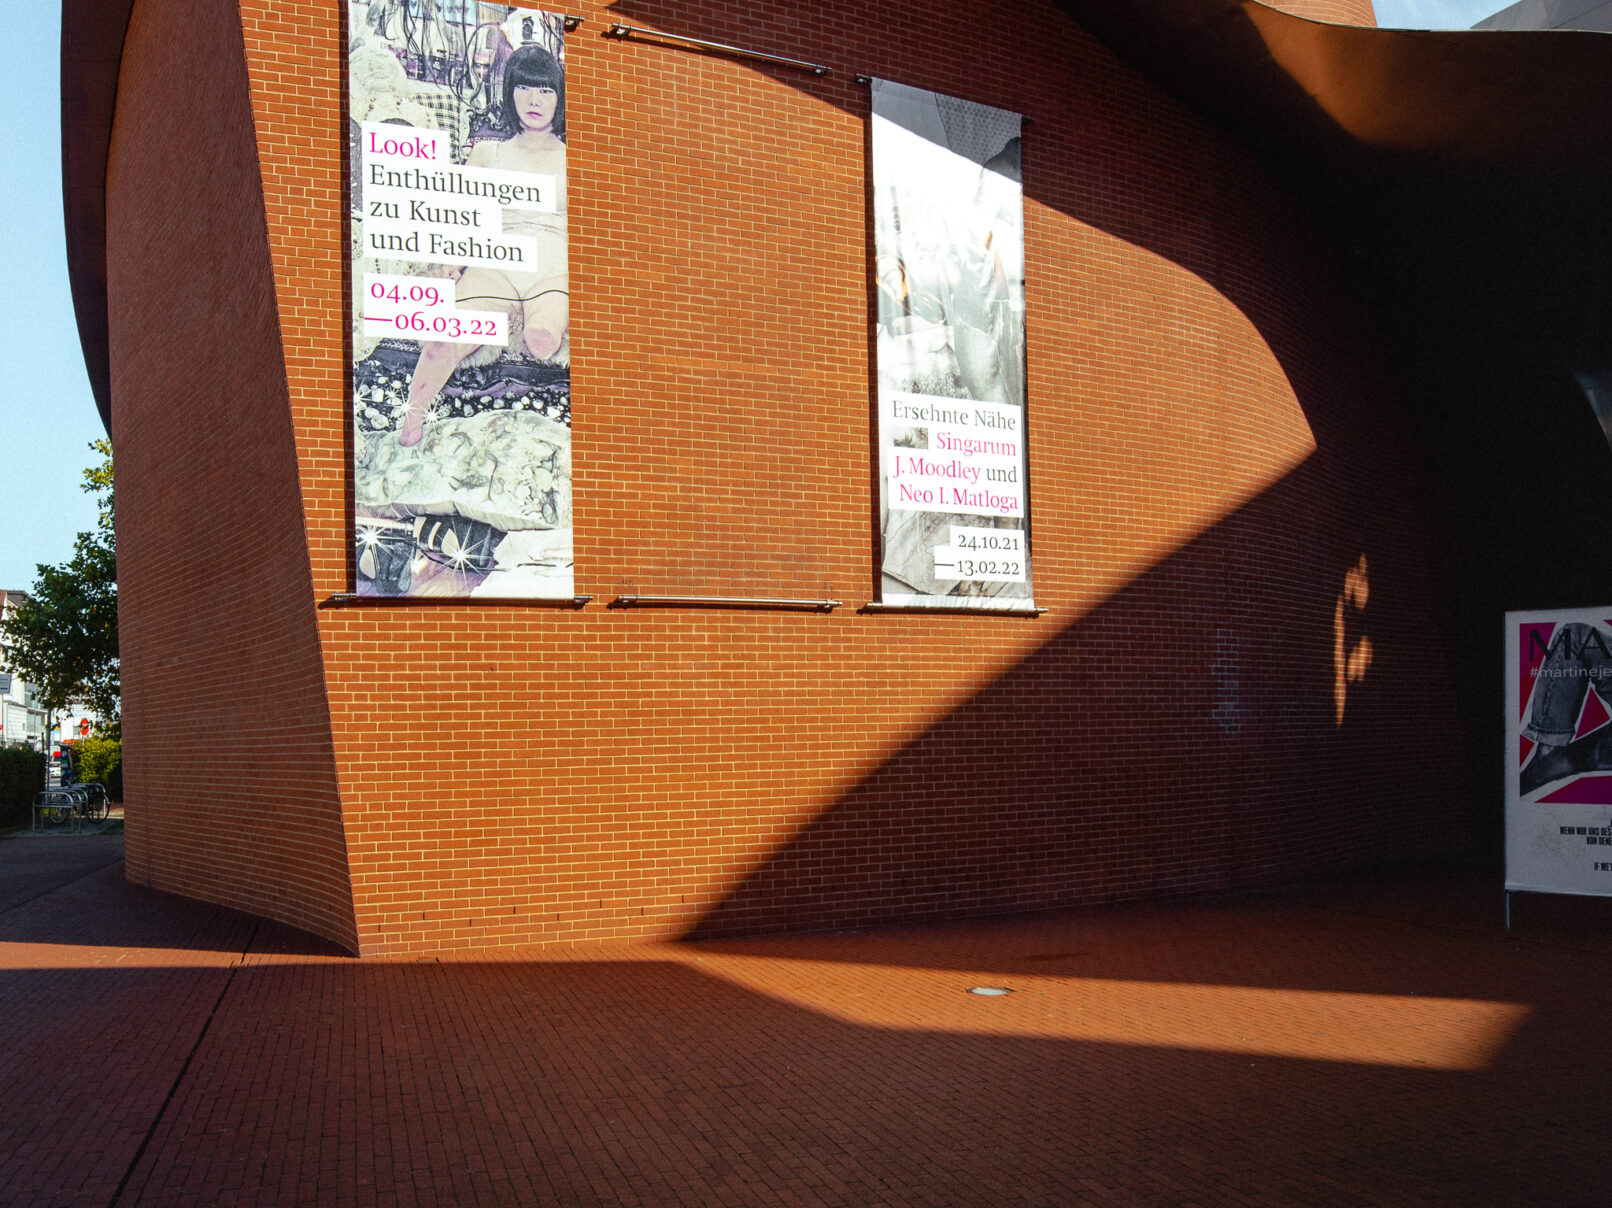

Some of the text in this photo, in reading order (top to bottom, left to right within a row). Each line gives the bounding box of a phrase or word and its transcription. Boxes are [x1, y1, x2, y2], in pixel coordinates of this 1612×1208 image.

[369, 131, 436, 160] Look!
[369, 163, 542, 205] Enthüllungen
[370, 199, 482, 227] zu Kunst
[370, 231, 524, 263] und Fashion
[370, 282, 444, 306] 04.09.
[892, 400, 1016, 431] Ersehnte Nähe
[936, 431, 1017, 457] Singarum
[893, 455, 1018, 485] J. Moodley und
[899, 483, 1018, 513] Neo I. Matloga
[957, 534, 1020, 551] 24.10.21
